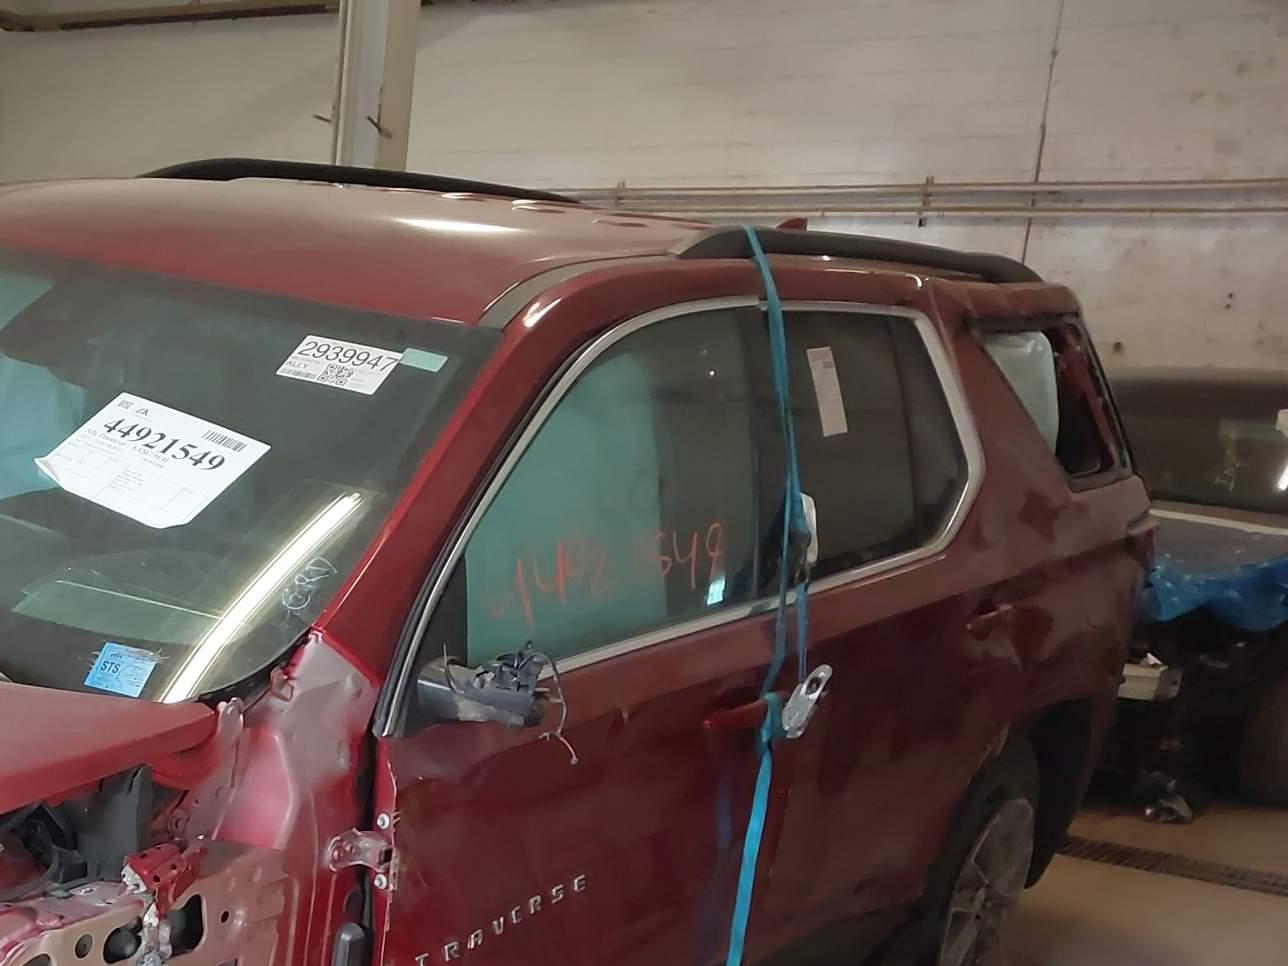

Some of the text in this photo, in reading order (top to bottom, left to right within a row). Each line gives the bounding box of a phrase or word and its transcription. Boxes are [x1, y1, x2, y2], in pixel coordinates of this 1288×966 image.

[298, 341, 400, 372] 2939947
[104, 417, 226, 471] 44921549
[100, 660, 121, 674] STS
